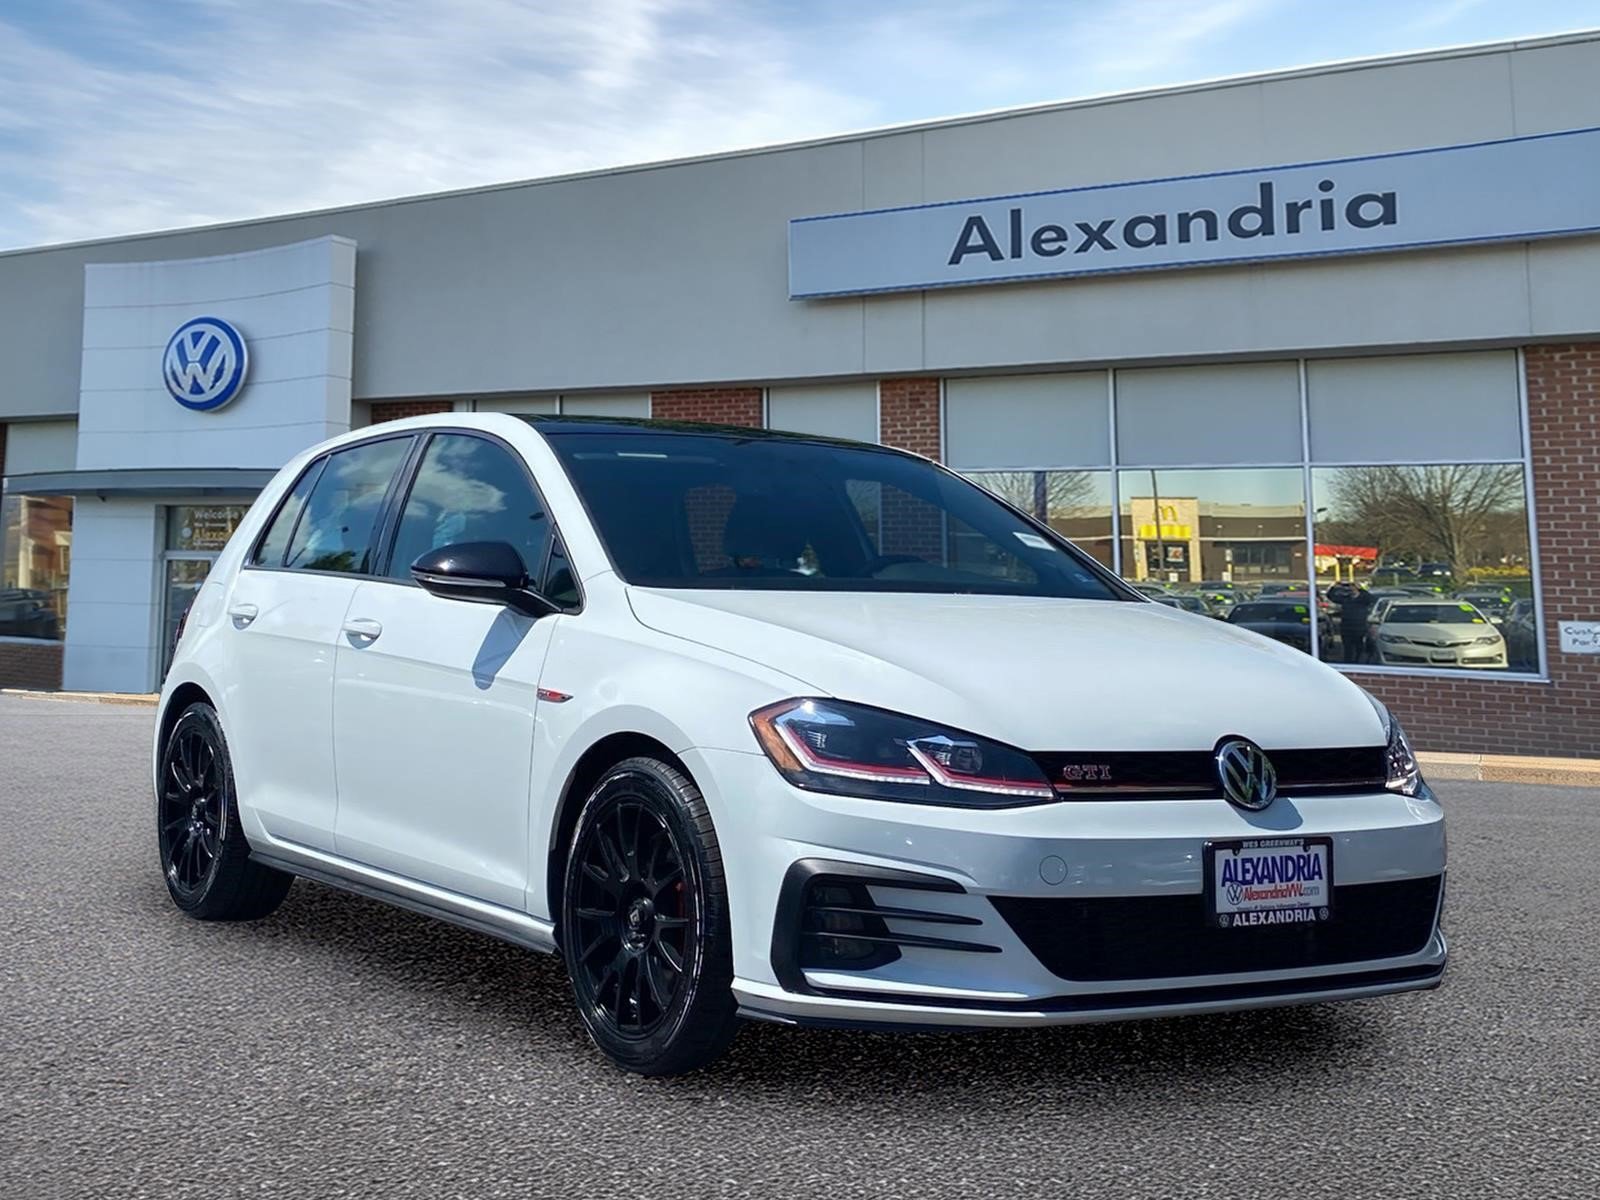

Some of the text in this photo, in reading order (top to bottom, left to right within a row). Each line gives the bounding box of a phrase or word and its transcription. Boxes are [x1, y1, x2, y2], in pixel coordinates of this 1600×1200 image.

[948, 179, 1397, 265] Alexandria
[194, 510, 239, 519] Welcome
[1064, 763, 1112, 781] GTI
[1221, 853, 1323, 887] ALEXANDRIA
[1232, 907, 1316, 927] ALEXANDRIA
